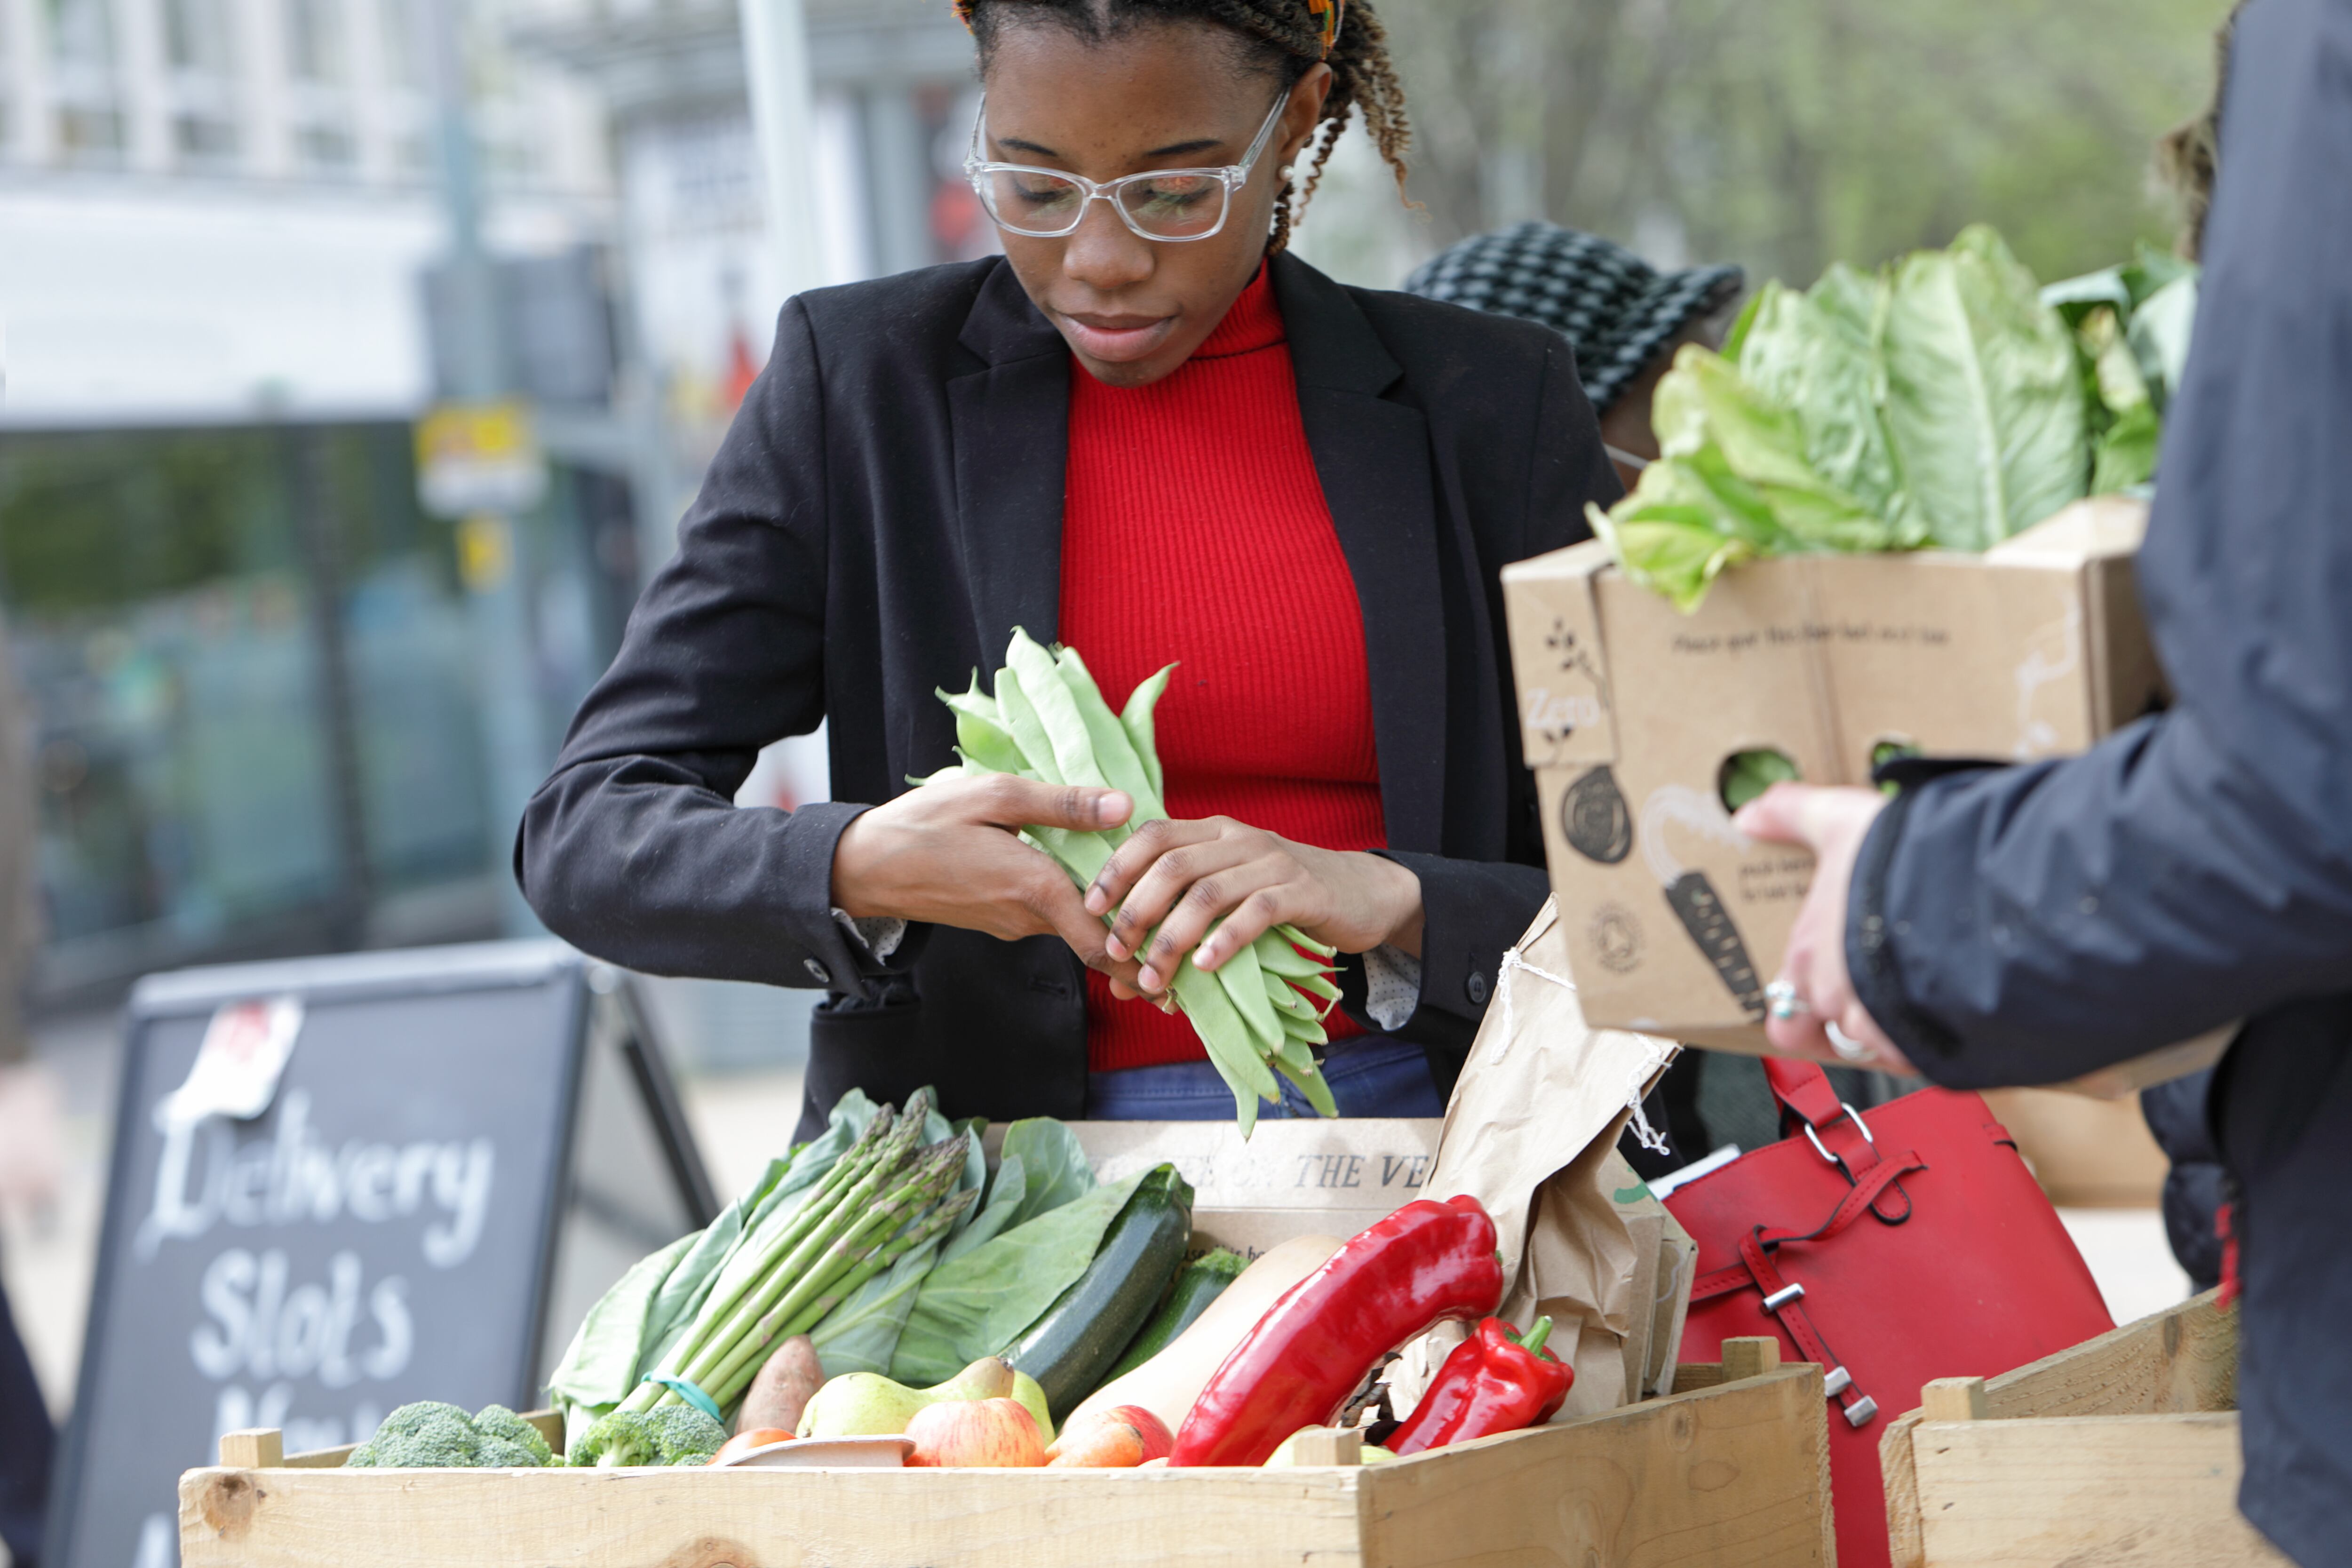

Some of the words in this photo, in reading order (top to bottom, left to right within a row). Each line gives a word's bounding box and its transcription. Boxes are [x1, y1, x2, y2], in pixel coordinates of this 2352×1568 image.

[1526, 688, 1600, 729] Zero
[133, 1084, 494, 1268] Delivery
[1294, 1154, 1366, 1188] THE
[1381, 1154, 1429, 1188] VE
[191, 1248, 414, 1389] Slots
